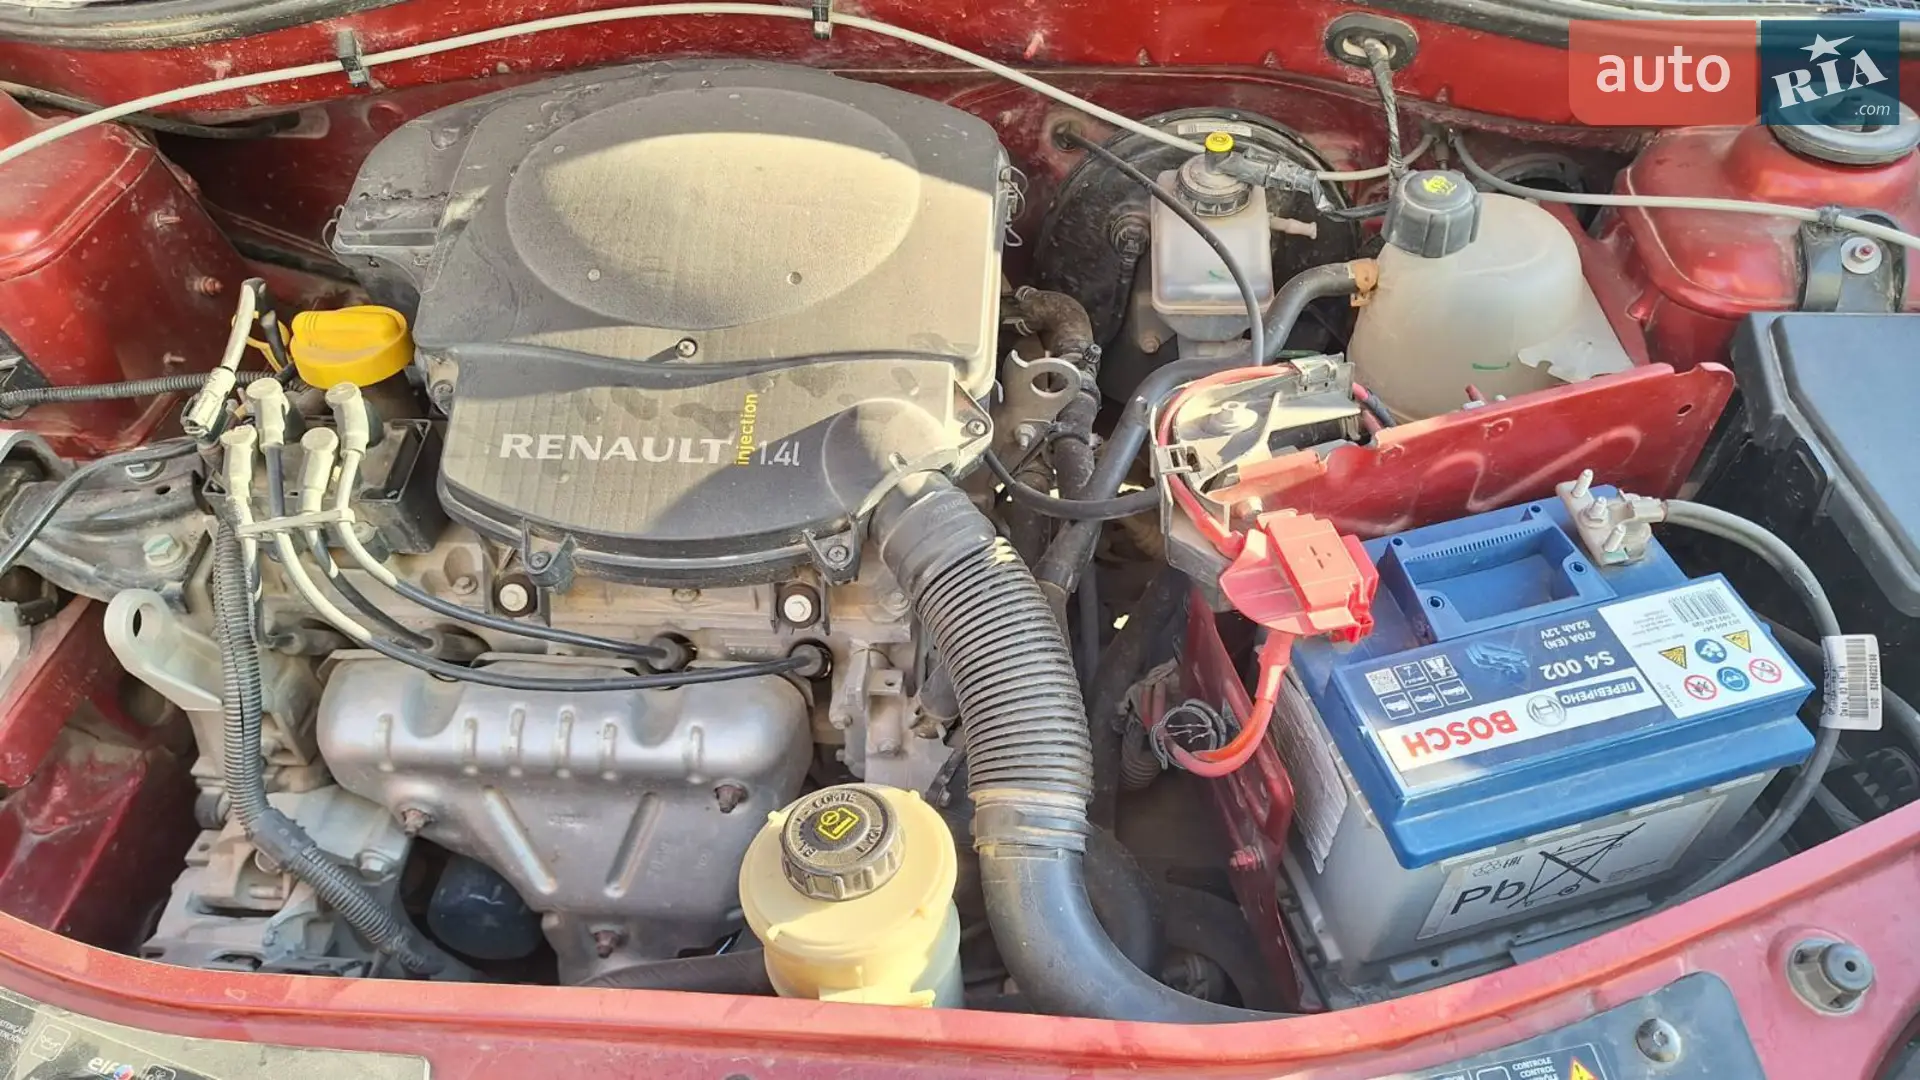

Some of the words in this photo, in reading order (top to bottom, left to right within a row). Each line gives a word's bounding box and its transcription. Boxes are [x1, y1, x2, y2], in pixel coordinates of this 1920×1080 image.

[734, 392, 758, 466] injection
[499, 432, 732, 464] RENAULT
[1540, 625, 1560, 639] 12V
[1562, 619, 1590, 635] 52Ah
[1571, 629, 1597, 644] 470A
[1543, 636, 1568, 650] (EN)
[1539, 658, 1583, 682] 002
[1583, 651, 1615, 671] S4
[1402, 710, 1518, 758] BOSCH
[1451, 879, 1525, 915] Pb
[88, 1057, 119, 1075] elf
